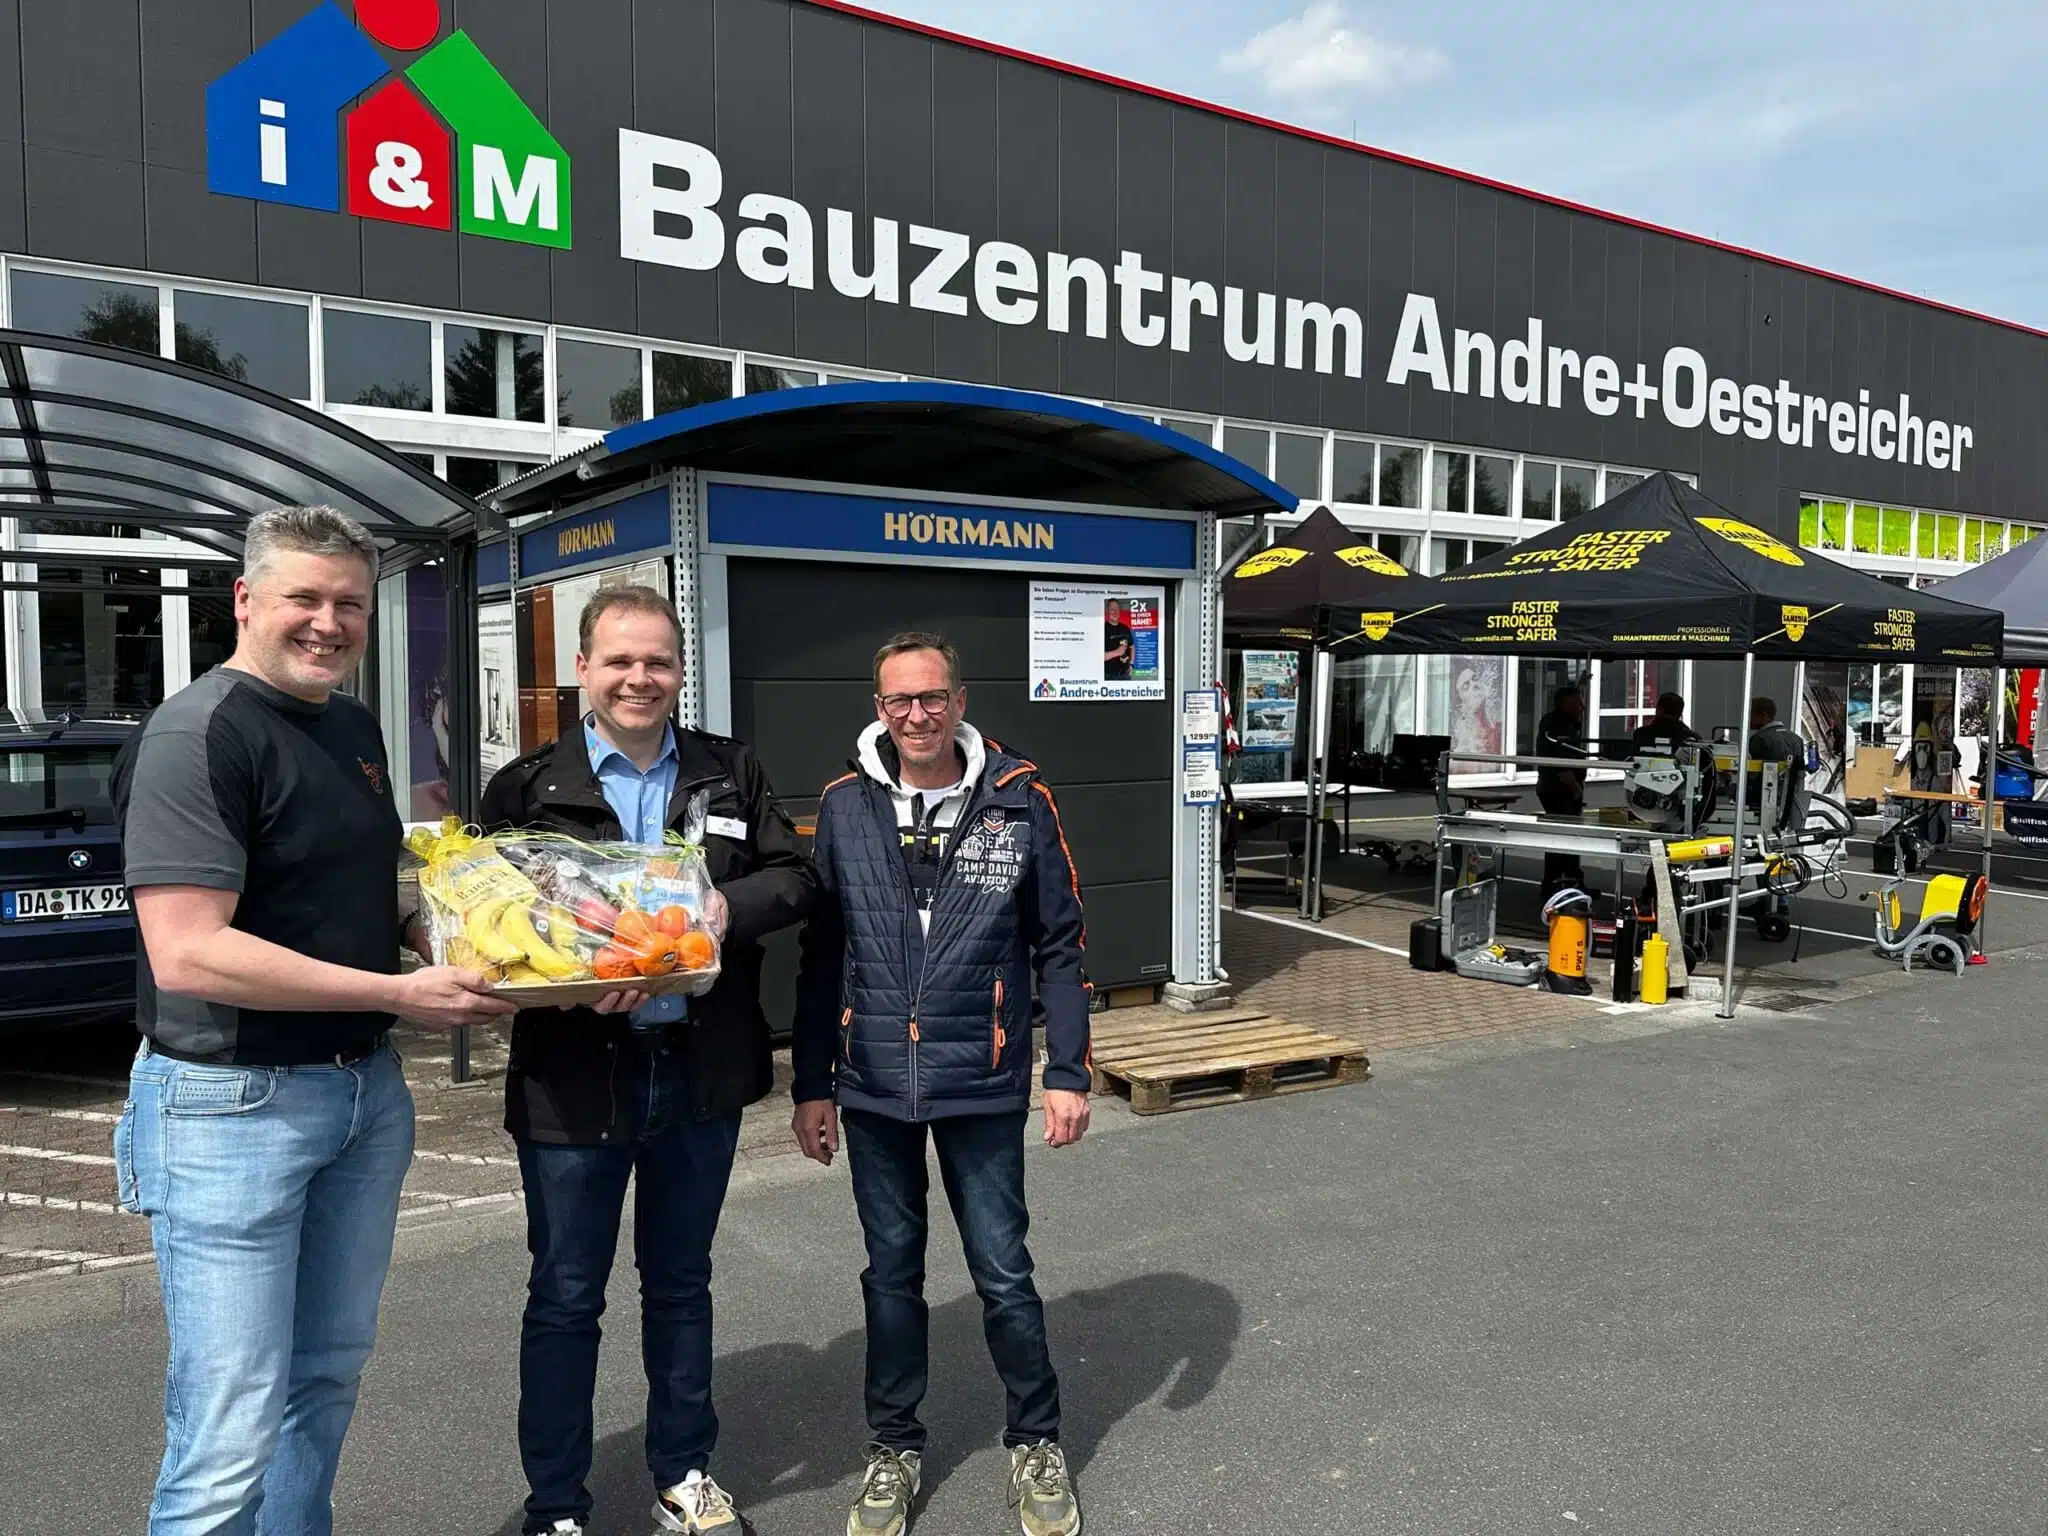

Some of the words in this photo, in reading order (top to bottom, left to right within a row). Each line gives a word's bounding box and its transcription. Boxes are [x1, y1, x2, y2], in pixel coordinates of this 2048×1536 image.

[474, 144, 558, 230] M
[619, 127, 1362, 379] Bauzentrum
[1386, 292, 1973, 472] Andre+Oestreicher
[558, 517, 615, 557] HÖRMANN
[884, 511, 1054, 550] HÖRMANN
[1568, 530, 1671, 547] FASTER
[1505, 544, 1645, 566] STRONGER
[1549, 557, 1640, 572] SAFER
[1512, 601, 1559, 614] FASTER
[1487, 615, 1553, 628] STRONGER
[1888, 609, 1916, 623] FASTER
[1516, 628, 1557, 641] SAFER
[1677, 626, 1732, 634] PROFESSIONELLE
[1873, 622, 1913, 637] STRONGER
[1892, 637, 1915, 651] SAFER
[1060, 686, 1163, 698] Andre+Oestreicher
[957, 861, 985, 873] CAMP
[988, 862, 1018, 876] DAVID
[964, 874, 1008, 885] AVIATION
[18, 892, 48, 914] DA
[66, 889, 96, 911] TK
